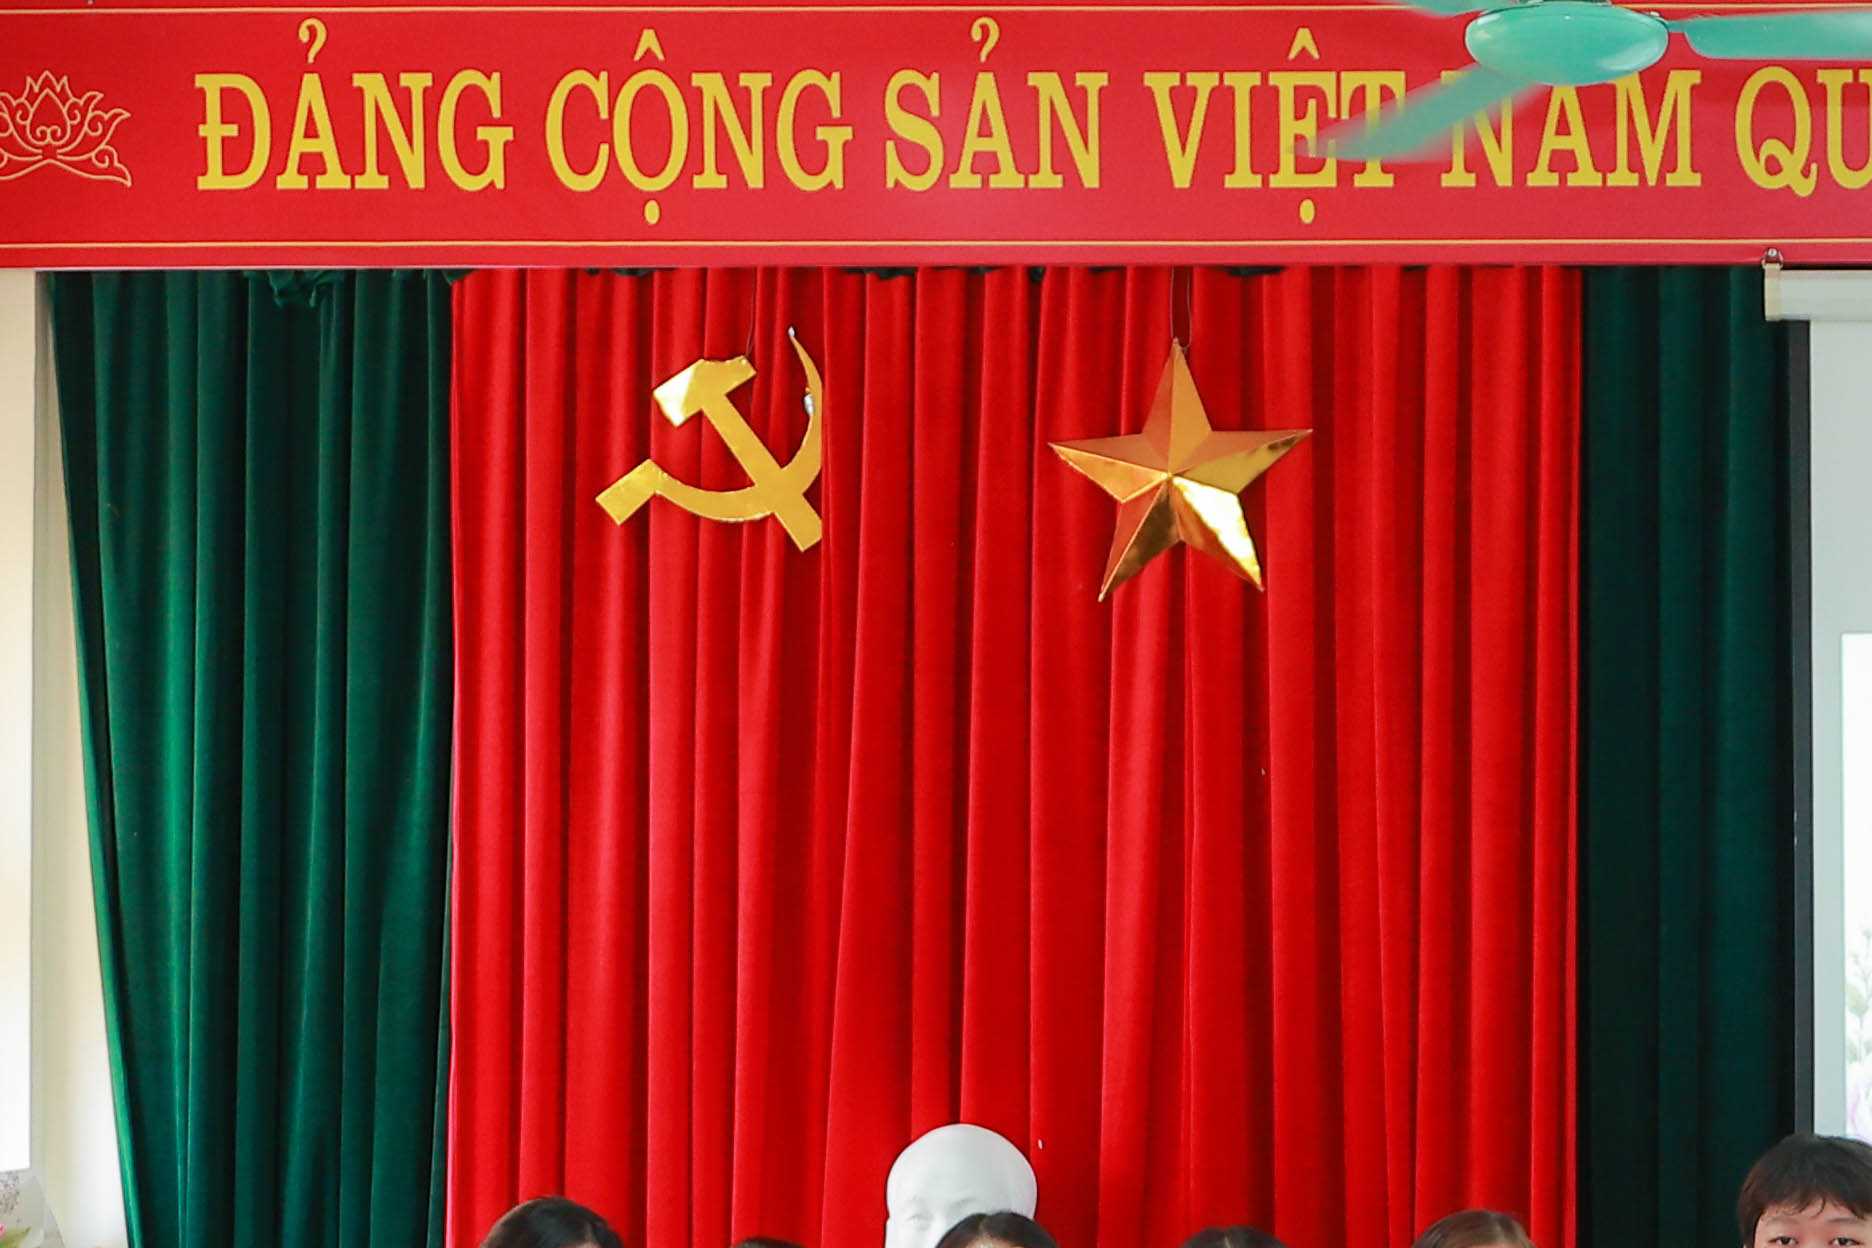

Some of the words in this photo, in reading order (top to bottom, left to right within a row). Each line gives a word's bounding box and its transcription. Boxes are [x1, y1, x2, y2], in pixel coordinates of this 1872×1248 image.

[194, 17, 514, 192] ĐẢNG
[545, 28, 853, 225] CỘNG
[884, 16, 1108, 192] SẢN
[1143, 26, 1406, 224] VIỆT
[1440, 68, 1702, 188] NAM
